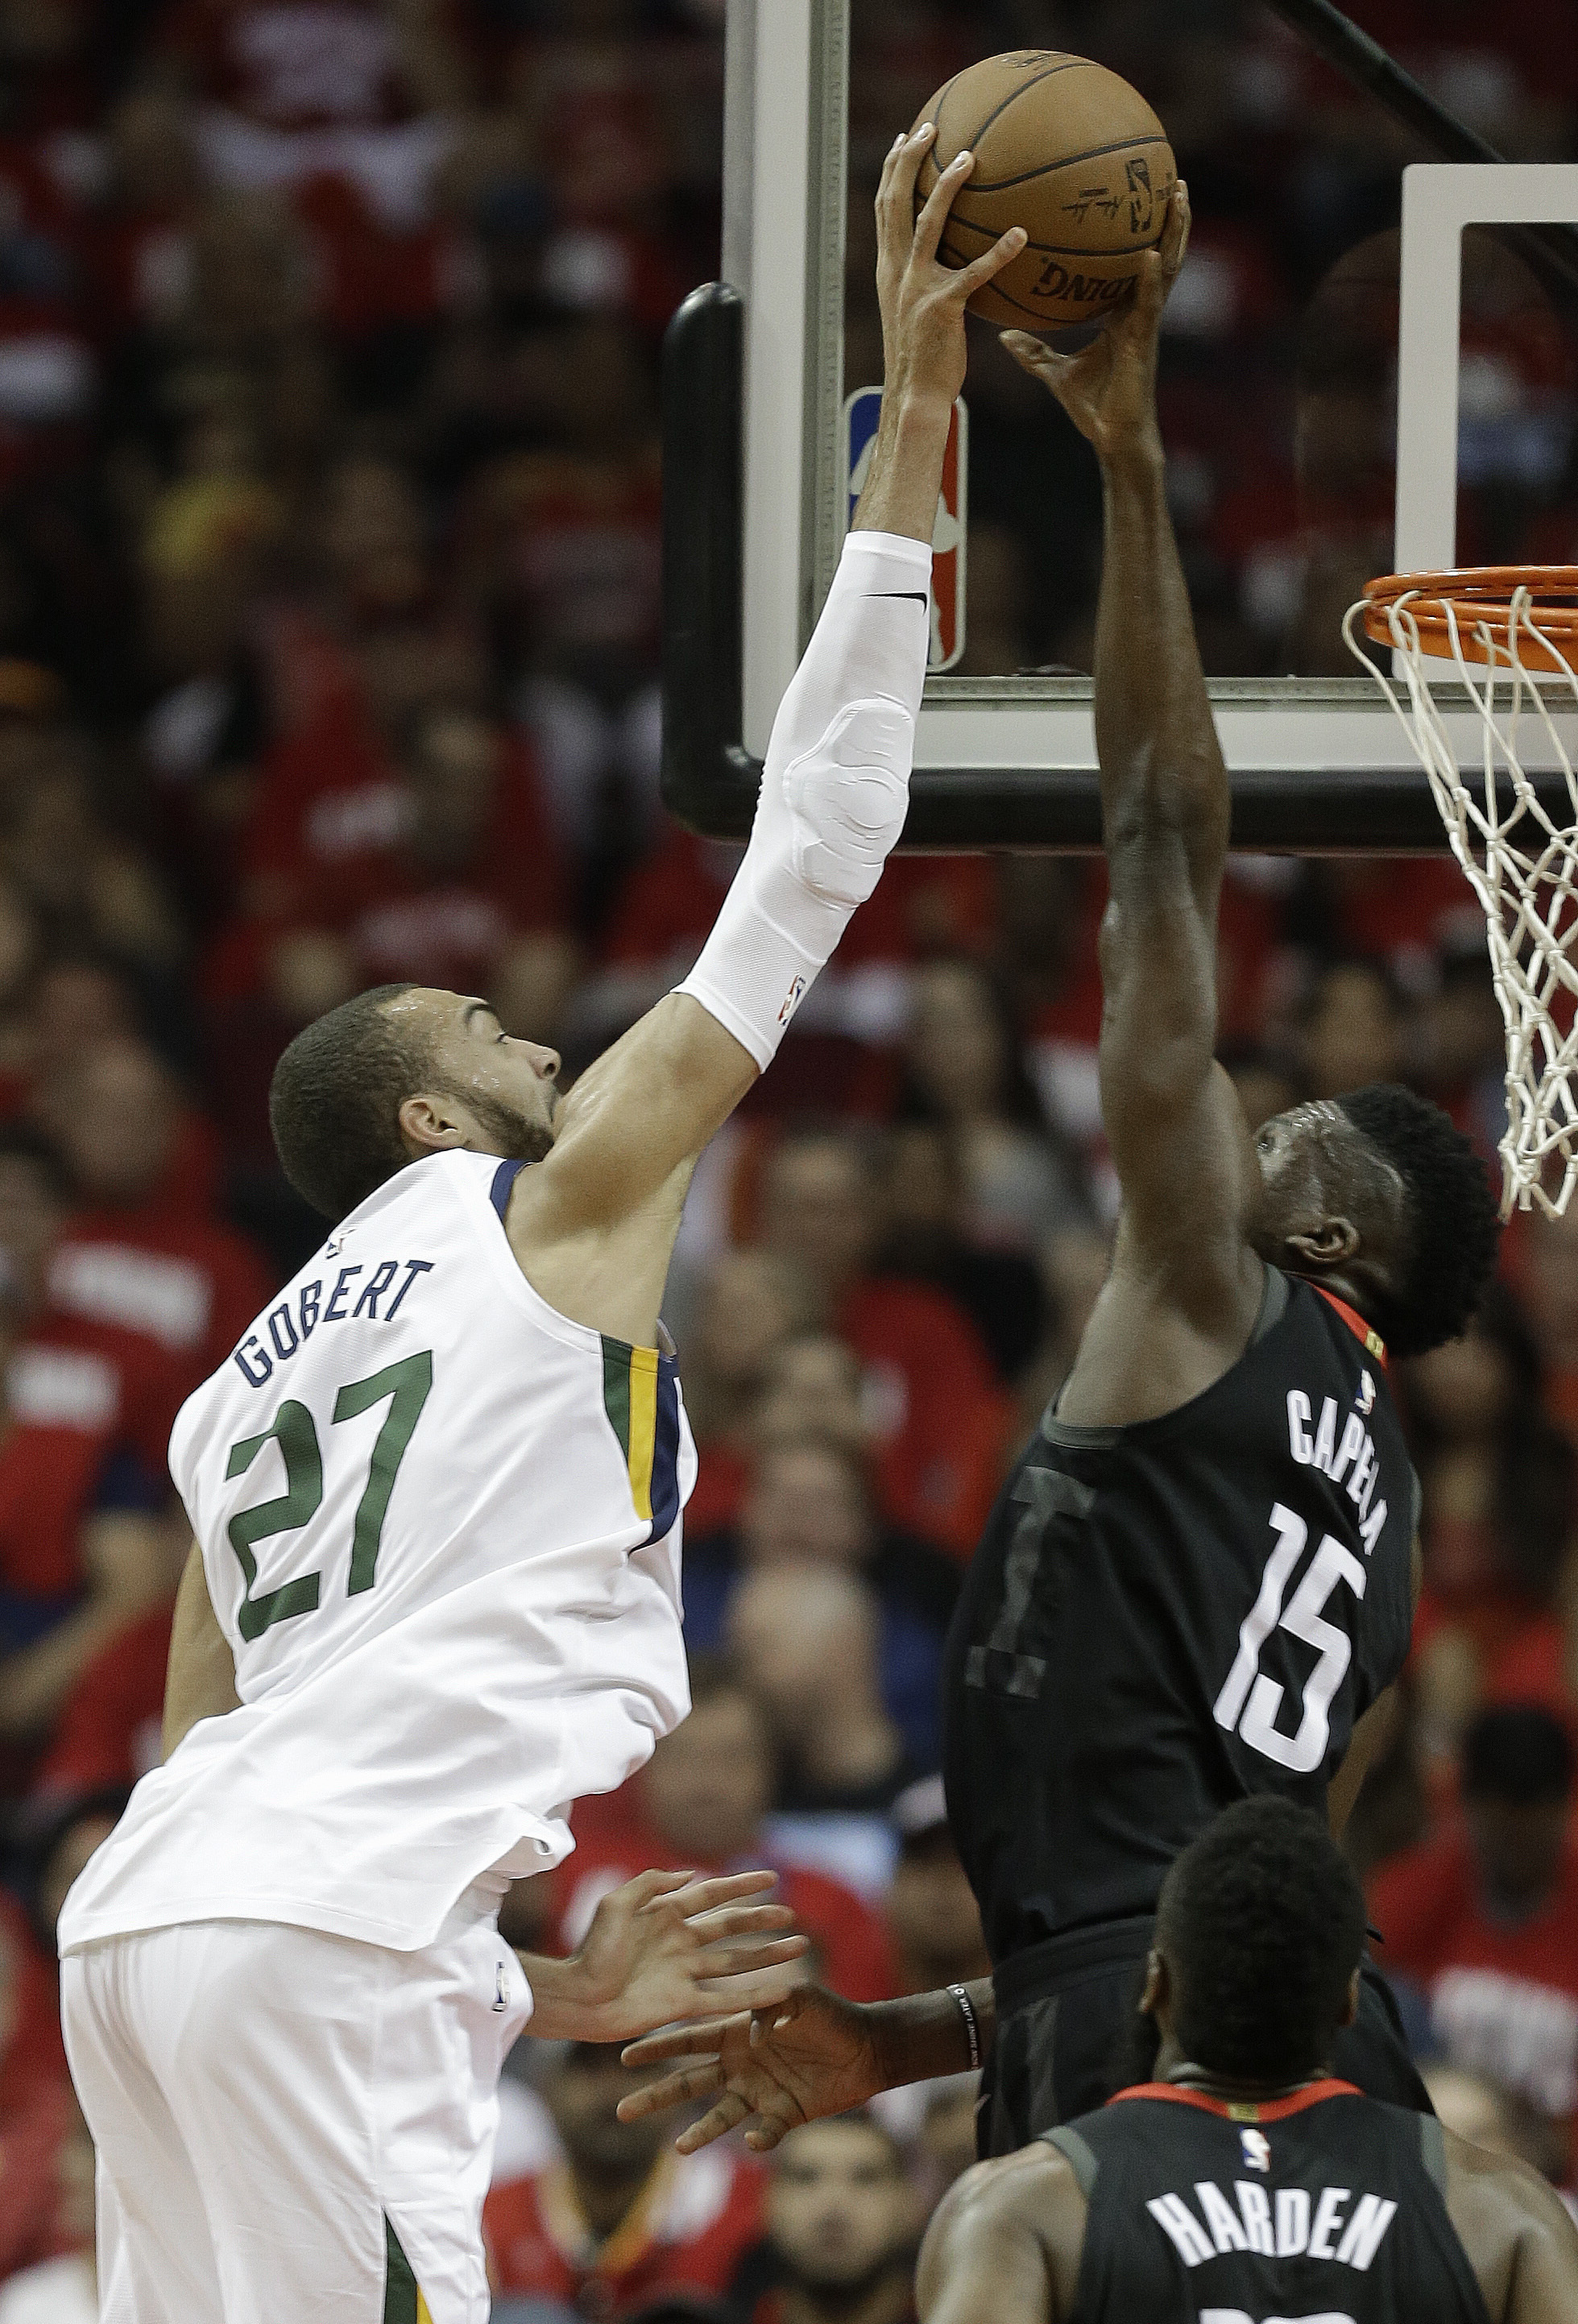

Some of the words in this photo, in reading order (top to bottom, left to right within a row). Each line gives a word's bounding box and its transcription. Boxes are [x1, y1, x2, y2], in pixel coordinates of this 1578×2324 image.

[234, 1259, 435, 1387] GOBERT
[225, 1348, 433, 1643] 27
[1212, 1502, 1368, 1773] 15
[1145, 2179, 1399, 2272] HARDEN
